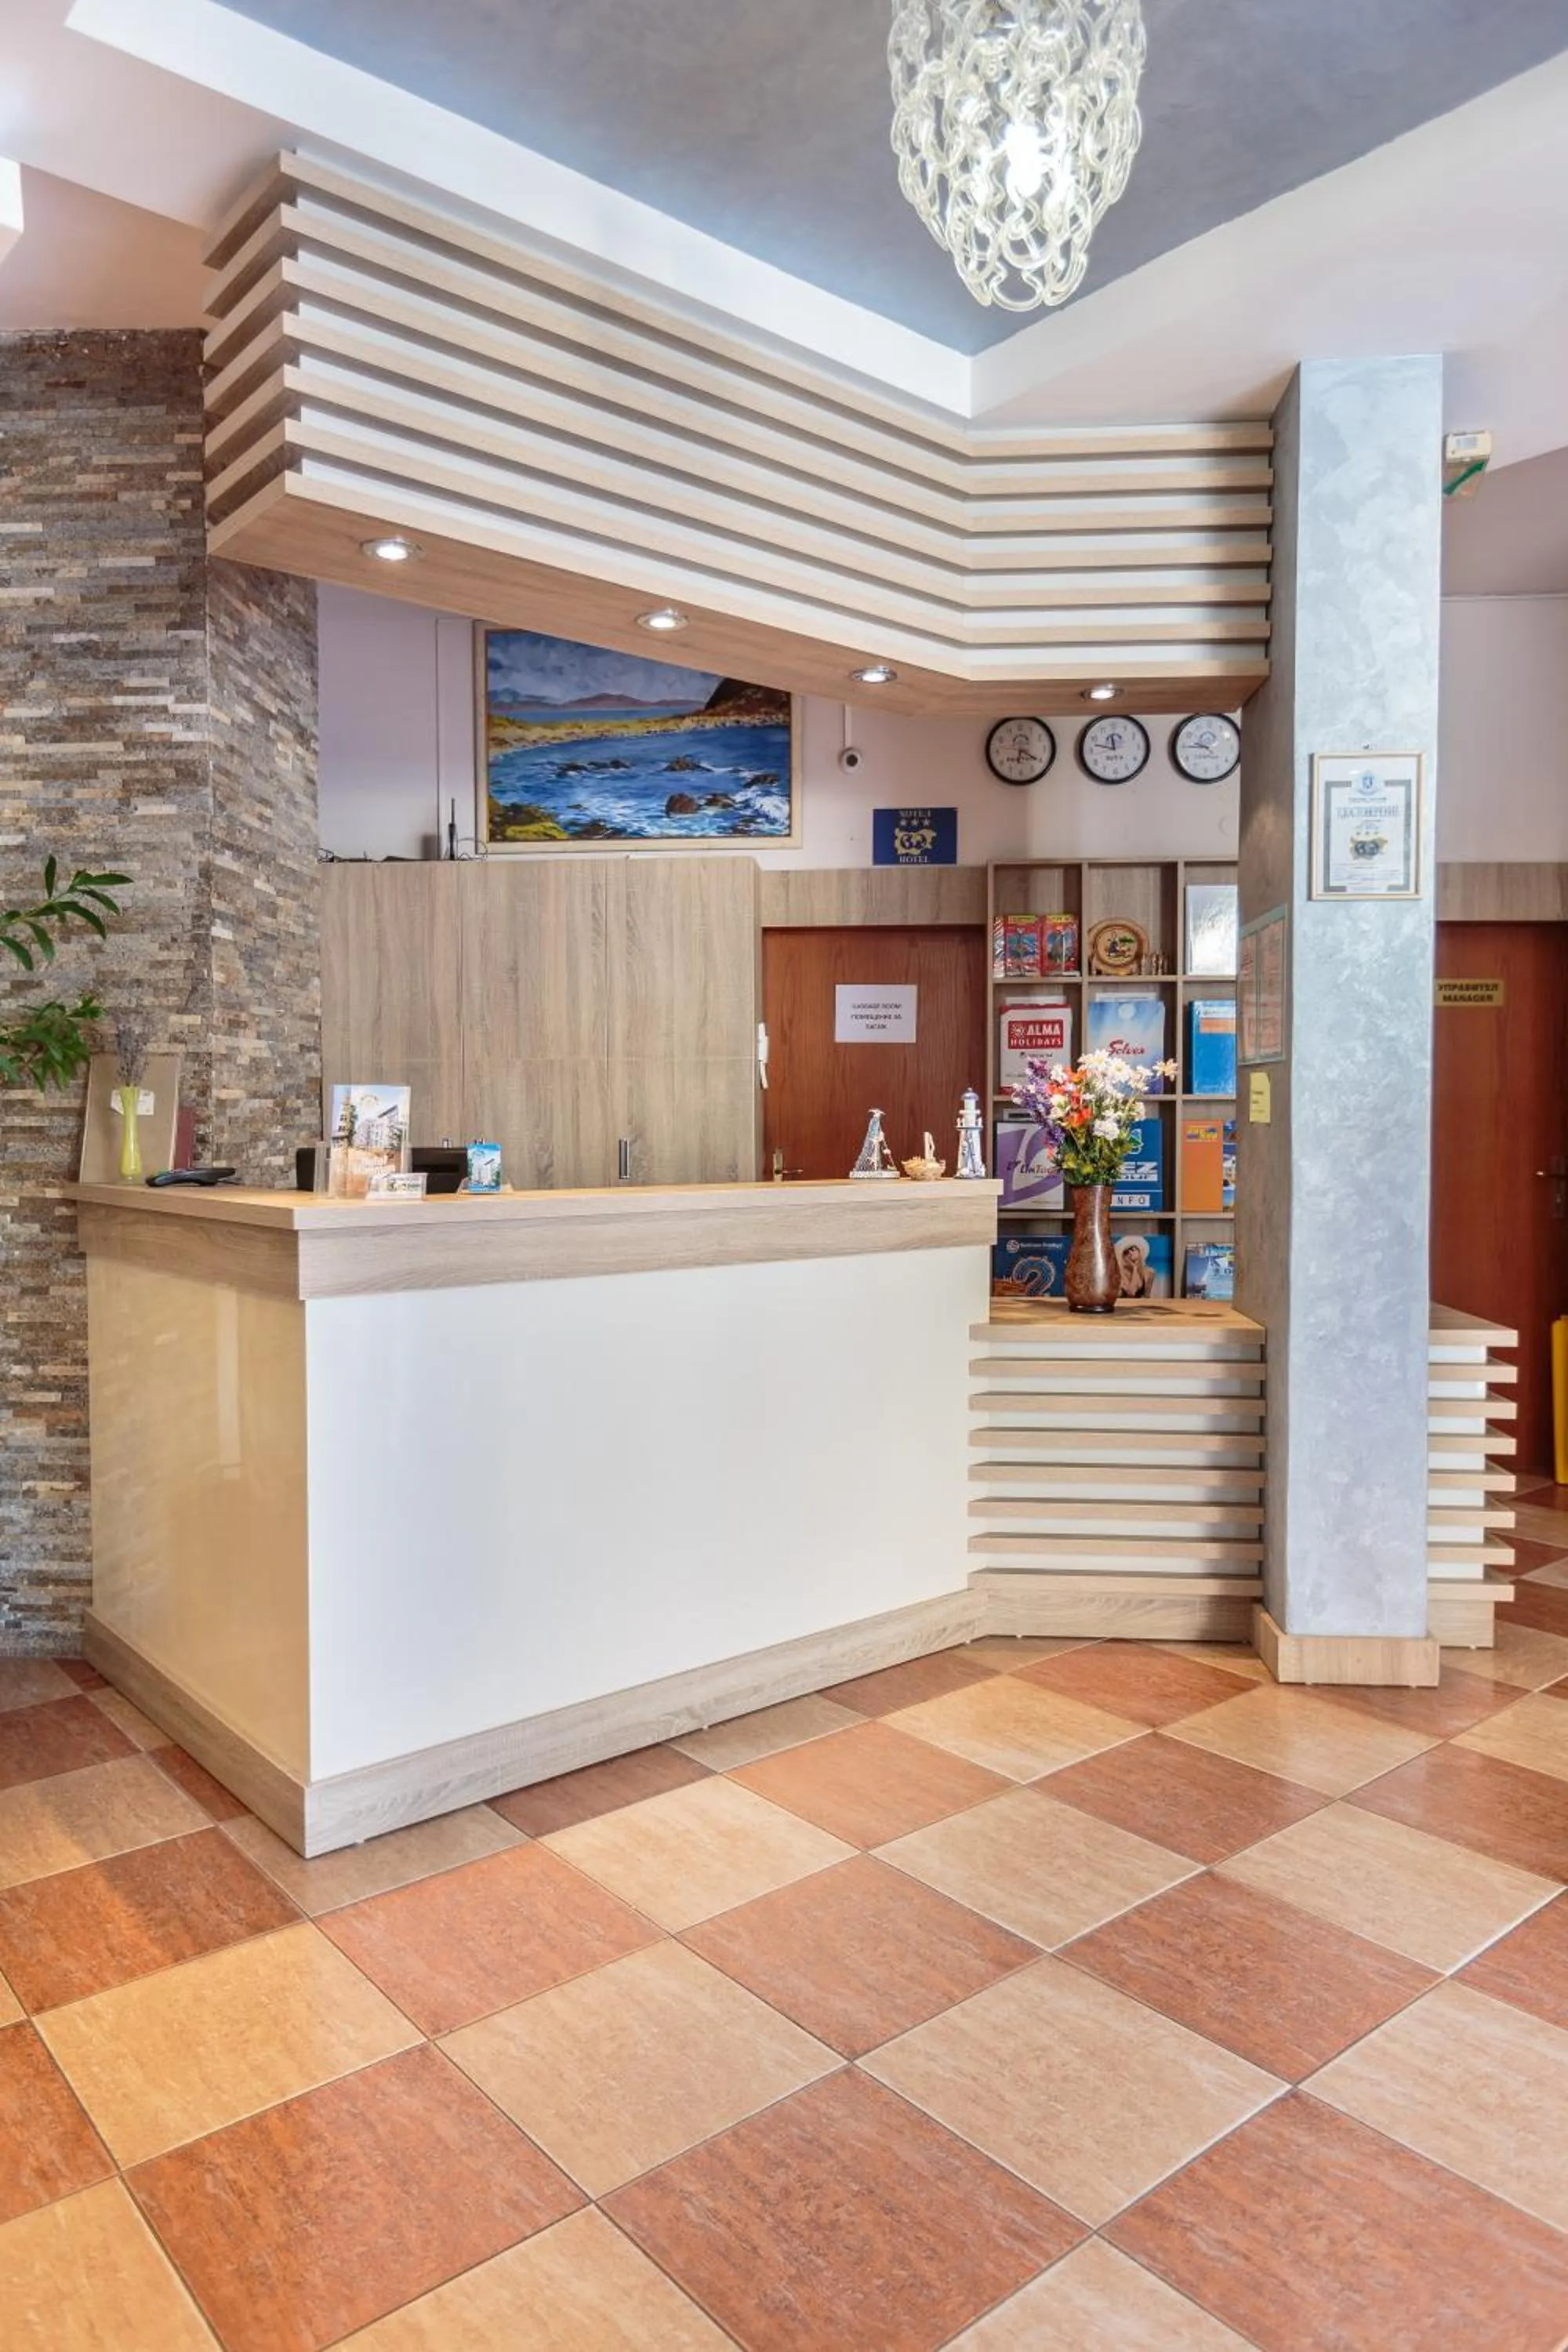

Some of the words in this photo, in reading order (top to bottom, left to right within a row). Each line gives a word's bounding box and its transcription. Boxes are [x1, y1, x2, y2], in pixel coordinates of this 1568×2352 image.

[1026, 1023, 1061, 1036] ALMA
[1010, 1037, 1062, 1047] HOLIDAYS
[1120, 1161, 1158, 1174] EZ
[1116, 1196, 1146, 1206] NFO
